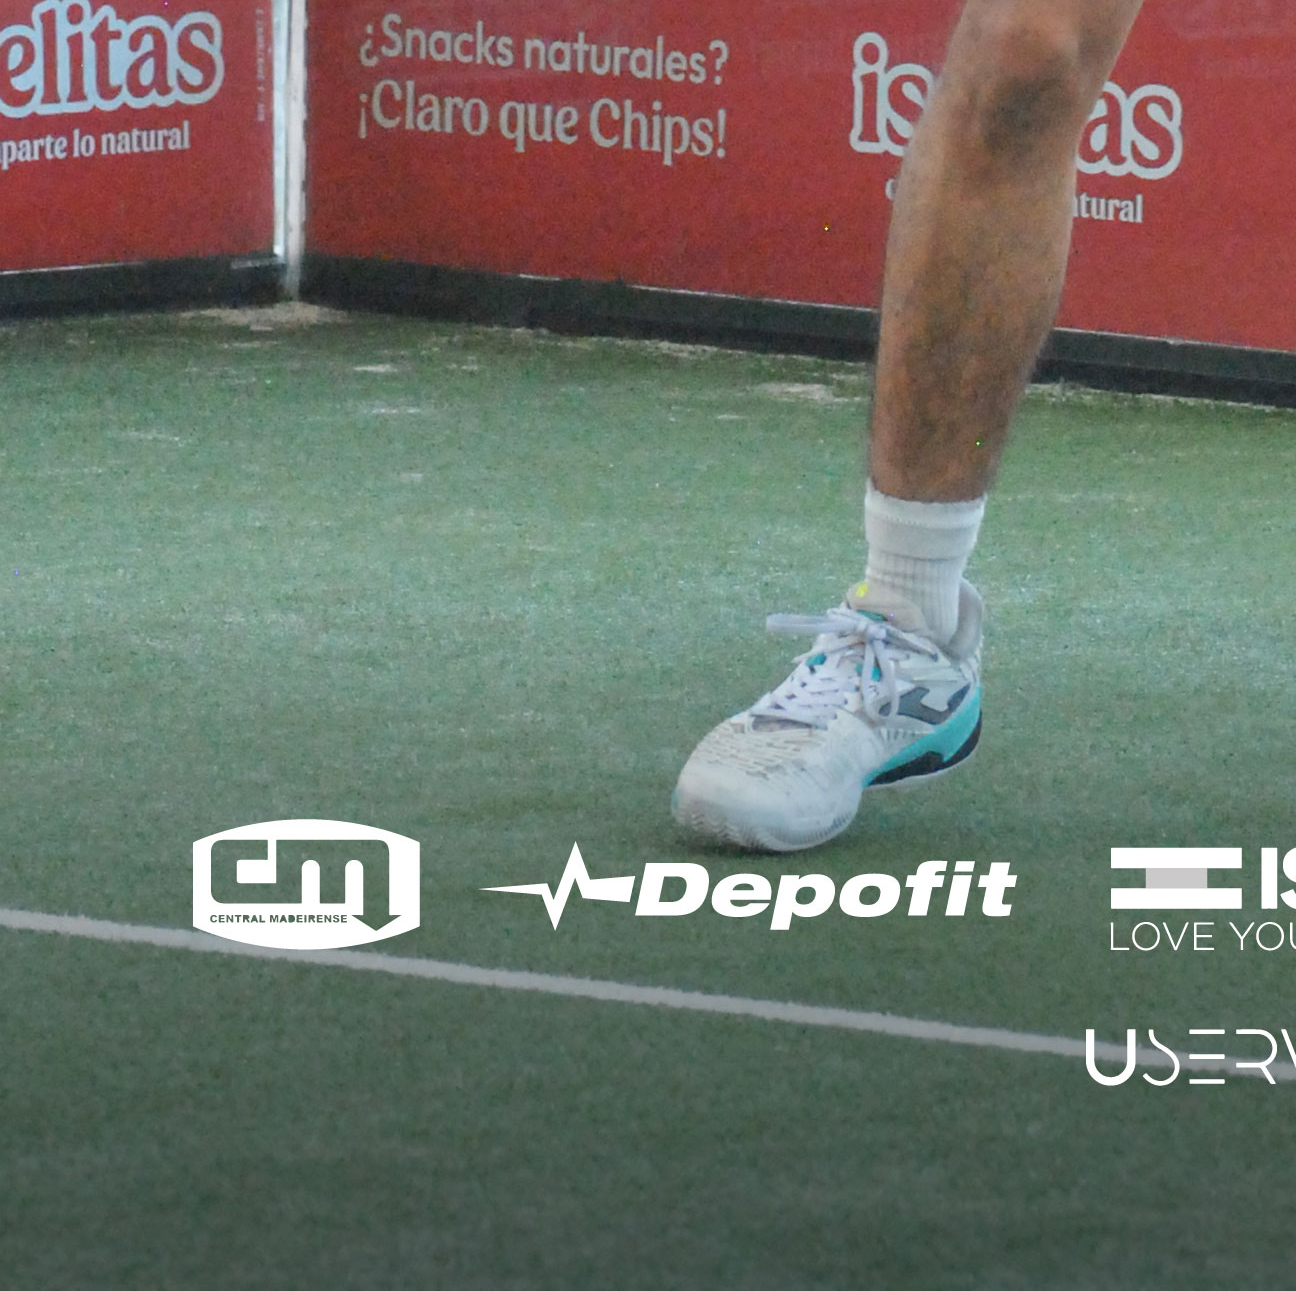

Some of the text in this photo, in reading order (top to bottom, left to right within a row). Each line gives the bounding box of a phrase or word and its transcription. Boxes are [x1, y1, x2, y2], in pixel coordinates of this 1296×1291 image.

[360, 13, 729, 85] ¿Snacks naturales?
[0, 120, 190, 171] parte lo natural
[358, 79, 726, 166] ¡Claro que Chips!
